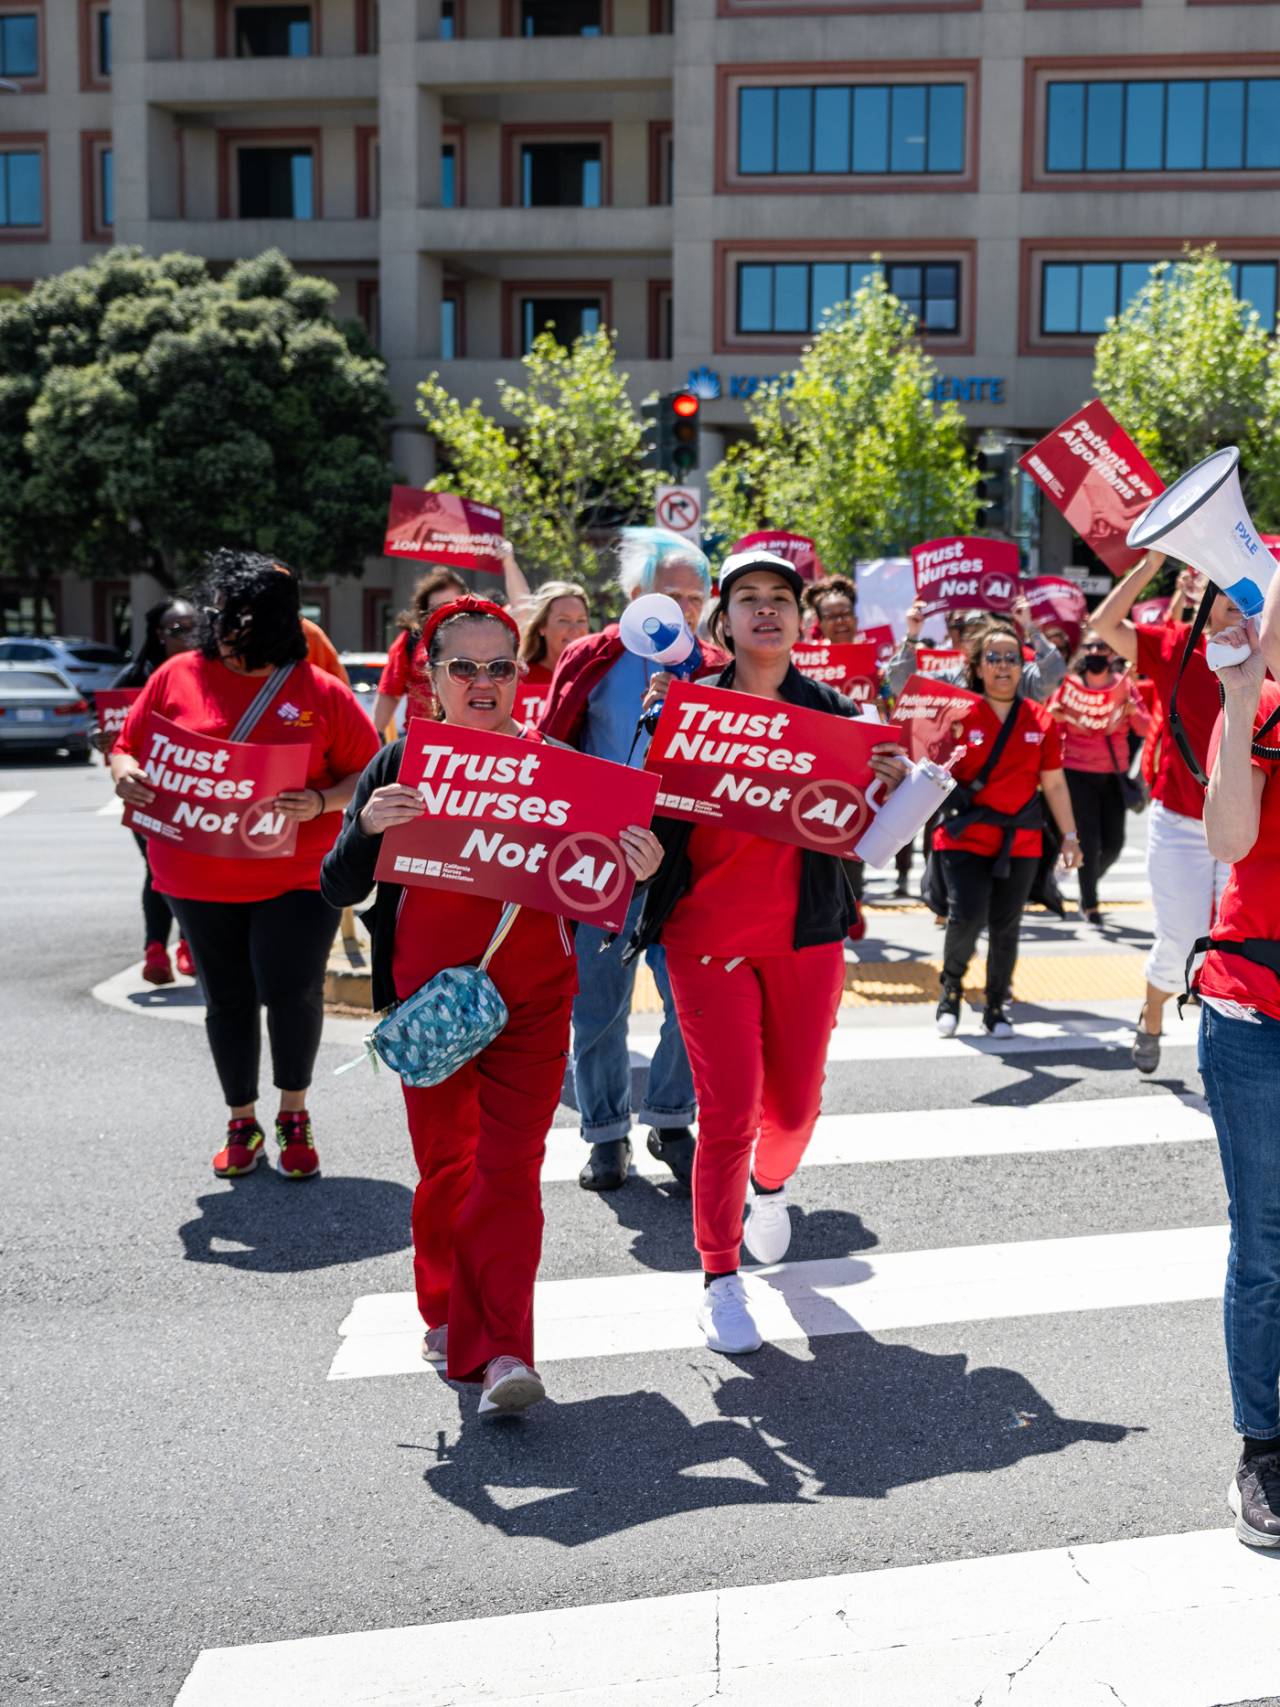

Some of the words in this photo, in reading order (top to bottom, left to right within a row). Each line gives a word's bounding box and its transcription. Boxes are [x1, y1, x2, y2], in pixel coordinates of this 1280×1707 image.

[1058, 429, 1135, 500] Algorithms
[1073, 420, 1131, 476] Patients
[1126, 470, 1153, 497] are
[916, 541, 965, 569] Trust
[917, 558, 983, 588] Nurses
[939, 580, 979, 598] Not
[986, 581, 1012, 598] AI
[920, 653, 966, 673] Trust
[849, 685, 870, 701] AI
[948, 698, 975, 710] NOT
[1064, 681, 1105, 704] Trust
[679, 702, 790, 740] Trust
[1080, 714, 1109, 729] Not
[151, 733, 231, 774] Trust
[421, 745, 540, 786] Trust
[664, 732, 816, 774] Nurses
[144, 759, 255, 800] Nurses
[173, 801, 239, 835] Not
[248, 811, 287, 836] AI
[416, 782, 572, 826] Nurses
[711, 773, 792, 812] Not
[801, 798, 858, 828] AI
[460, 828, 548, 874] Not
[560, 855, 616, 892] AI
